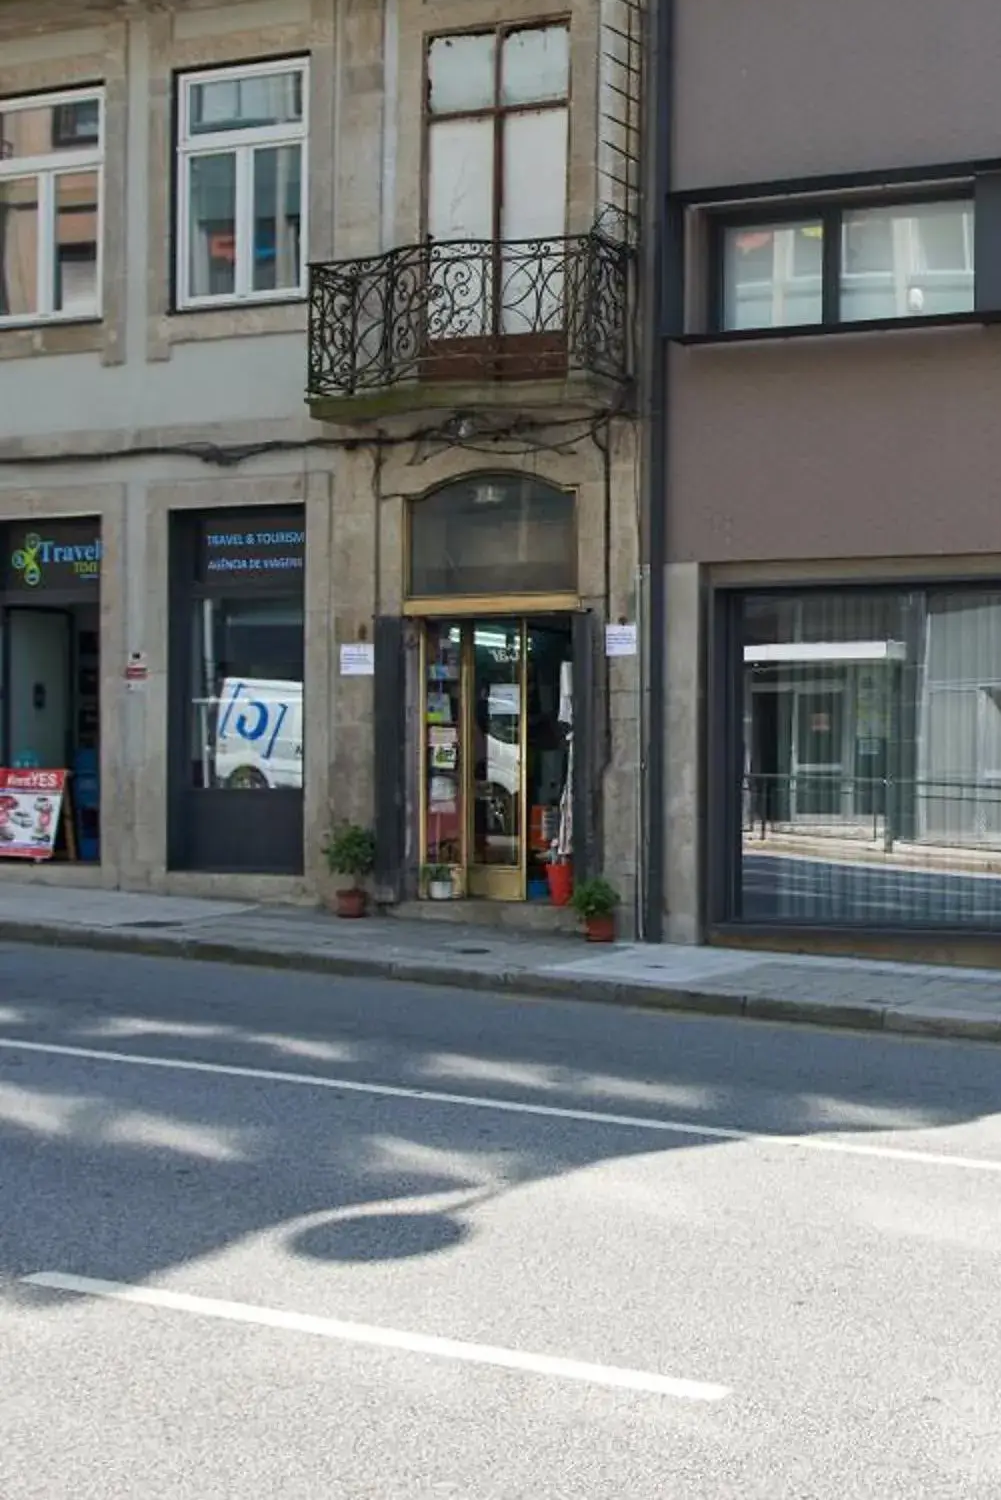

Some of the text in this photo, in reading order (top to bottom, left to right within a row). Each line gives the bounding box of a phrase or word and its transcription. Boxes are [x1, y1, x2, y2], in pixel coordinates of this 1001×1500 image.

[208, 534, 244, 545] TRAVEL
[246, 533, 255, 545] &
[249, 558, 261, 569] DE
